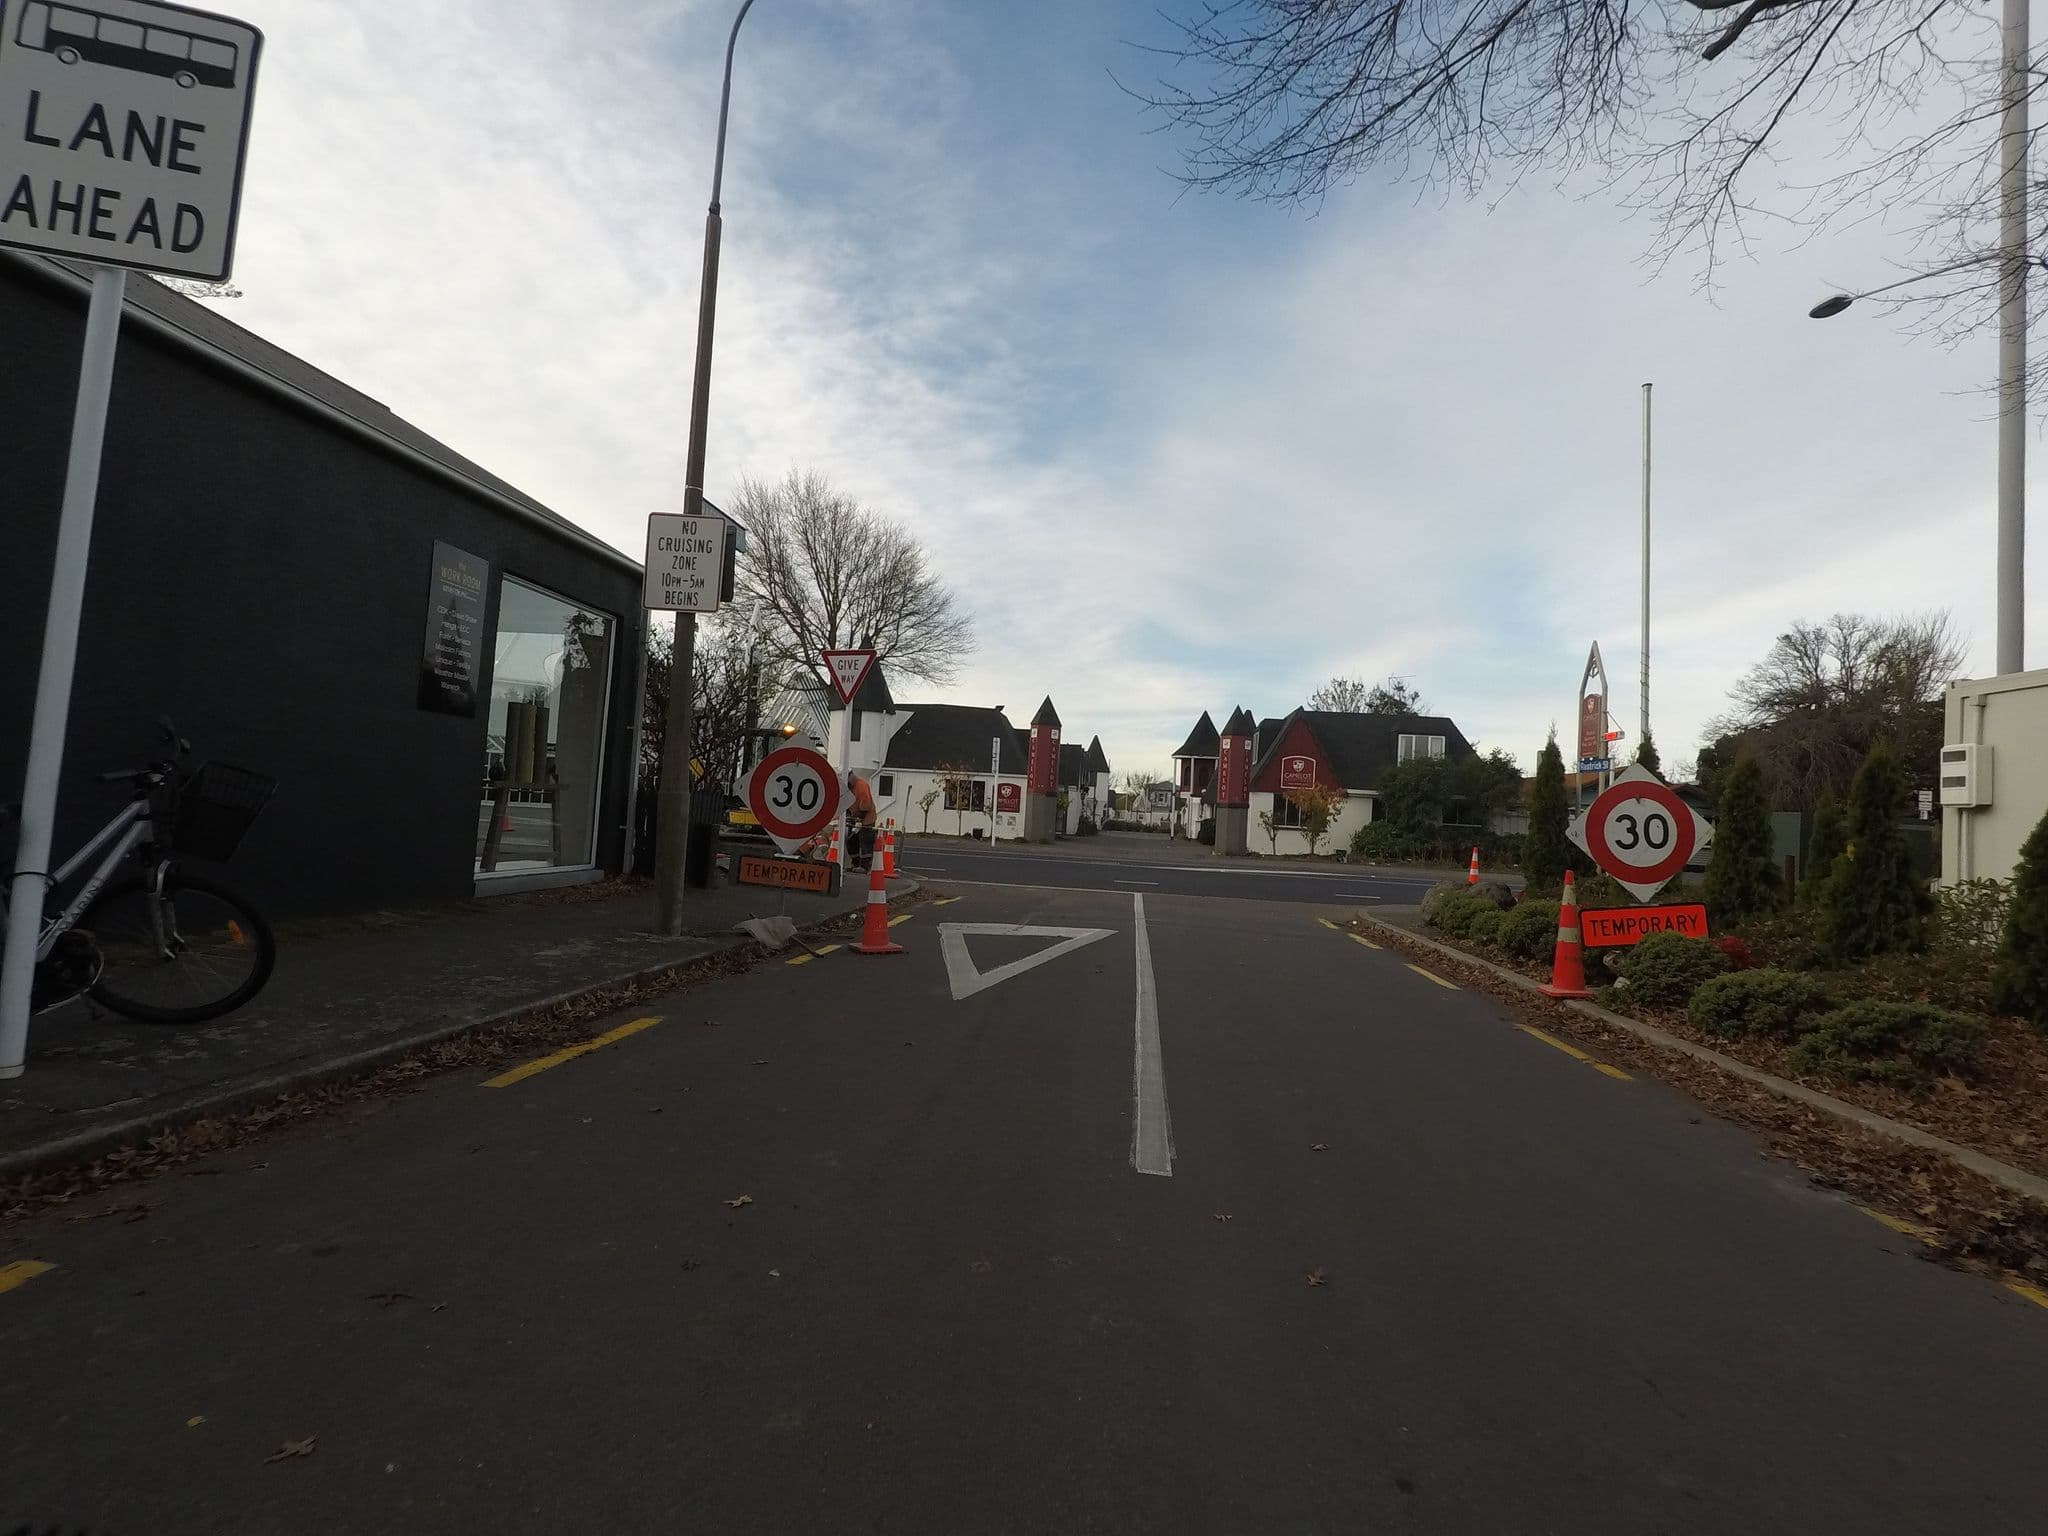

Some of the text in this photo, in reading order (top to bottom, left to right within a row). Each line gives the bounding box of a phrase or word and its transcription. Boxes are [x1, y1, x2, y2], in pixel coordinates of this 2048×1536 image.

[24, 89, 206, 175] LANE
[0, 174, 205, 253] AHEAD
[682, 520, 697, 535] NO
[658, 537, 713, 554] CRUISING
[672, 555, 697, 571] ZONE
[664, 590, 699, 607] BEGINS
[837, 659, 859, 671] GIVE
[841, 675, 855, 684] WAY
[772, 775, 819, 810] 30
[1615, 813, 1669, 850] 30
[746, 863, 824, 886] TEMPORARY
[1590, 914, 1698, 937] TEMPORARY
